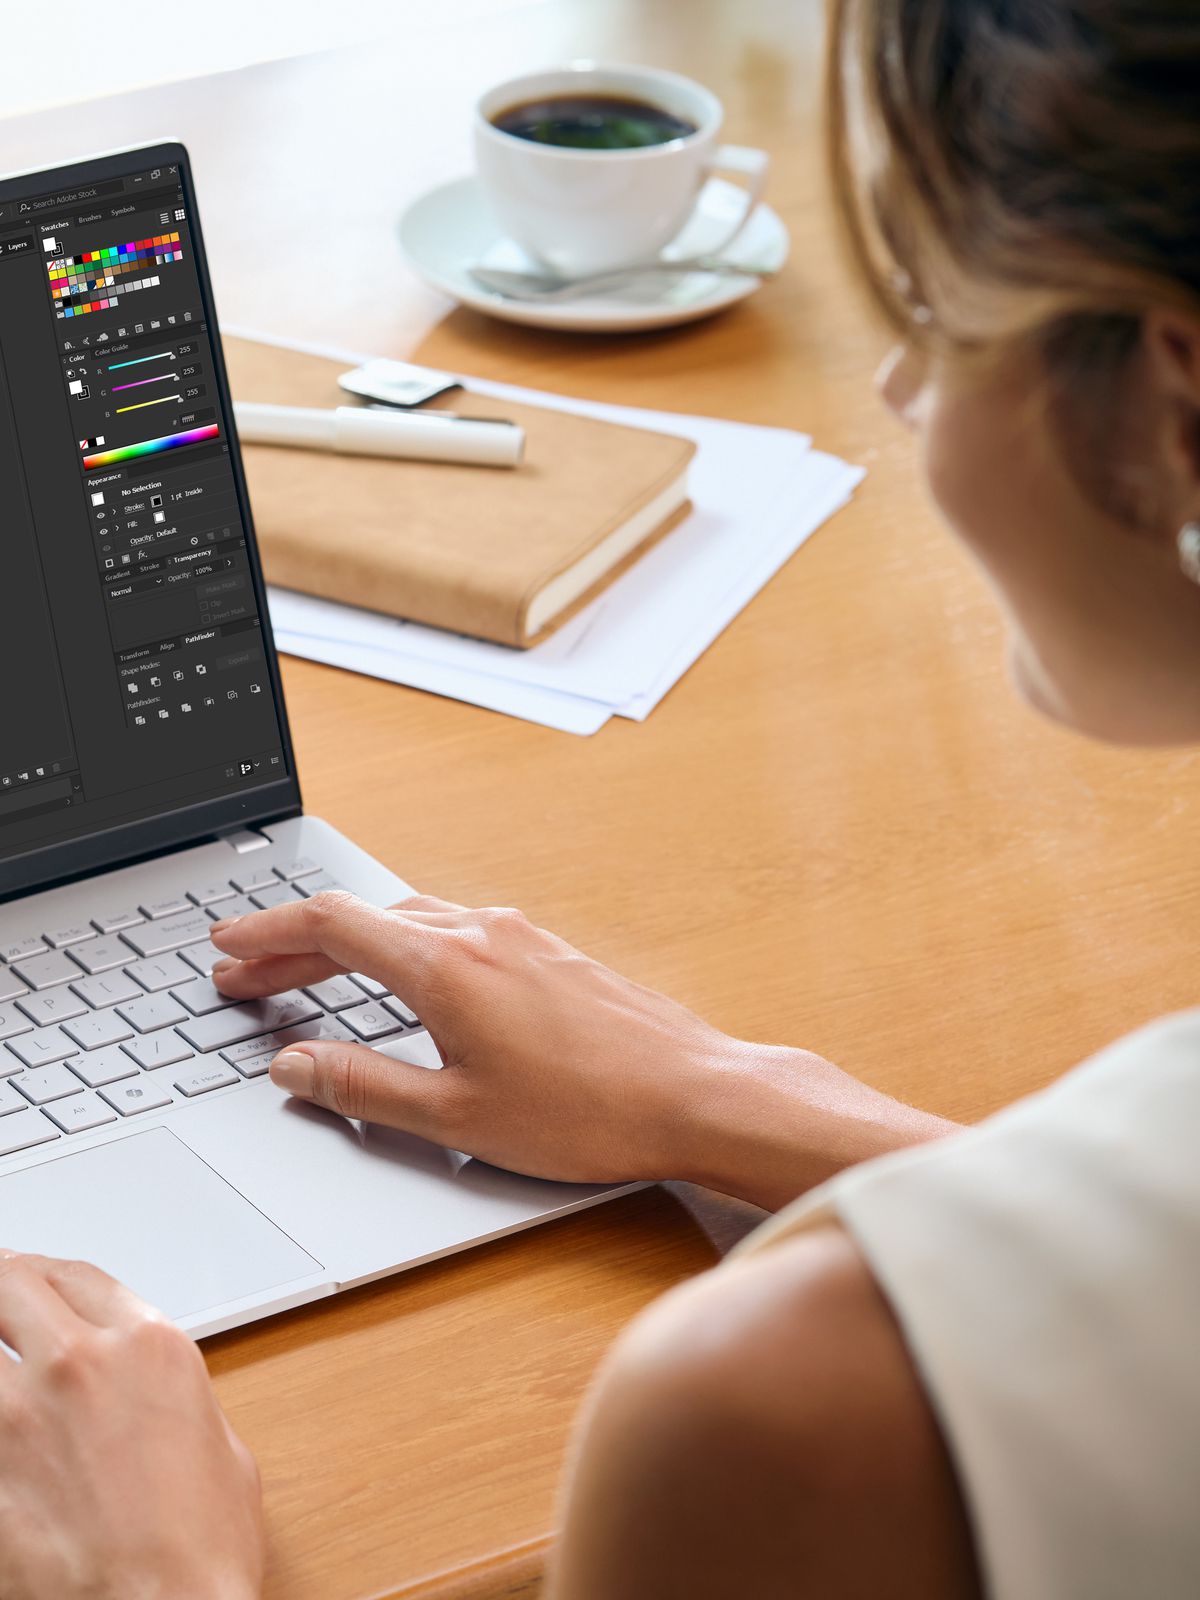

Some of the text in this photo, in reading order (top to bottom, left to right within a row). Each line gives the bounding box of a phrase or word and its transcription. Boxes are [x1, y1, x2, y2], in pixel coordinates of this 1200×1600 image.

[33, 189, 97, 209] Search Adobe Stock
[111, 206, 135, 216] Symbols
[78, 215, 102, 223] Brushes
[41, 222, 69, 232] Swatches
[8, 242, 27, 250] Layers
[111, 344, 128, 352] Guide
[179, 346, 191, 354] 255
[183, 367, 194, 375] 255
[187, 388, 198, 396] 255
[88, 474, 121, 486] Appearance
[132, 482, 162, 493] Selection
[185, 488, 203, 496] Inside
[130, 527, 177, 546] Opacity: Default
[174, 550, 211, 563] Transparency
[140, 564, 159, 572] Stroke
[195, 566, 212, 575] 100%
[105, 570, 130, 581] Gradient
[168, 572, 191, 582] Opacity:
[111, 586, 132, 597] Normal
[185, 632, 215, 643] Pathfinder
[120, 650, 149, 661] Transform
[121, 662, 160, 676] Shape Modes:
